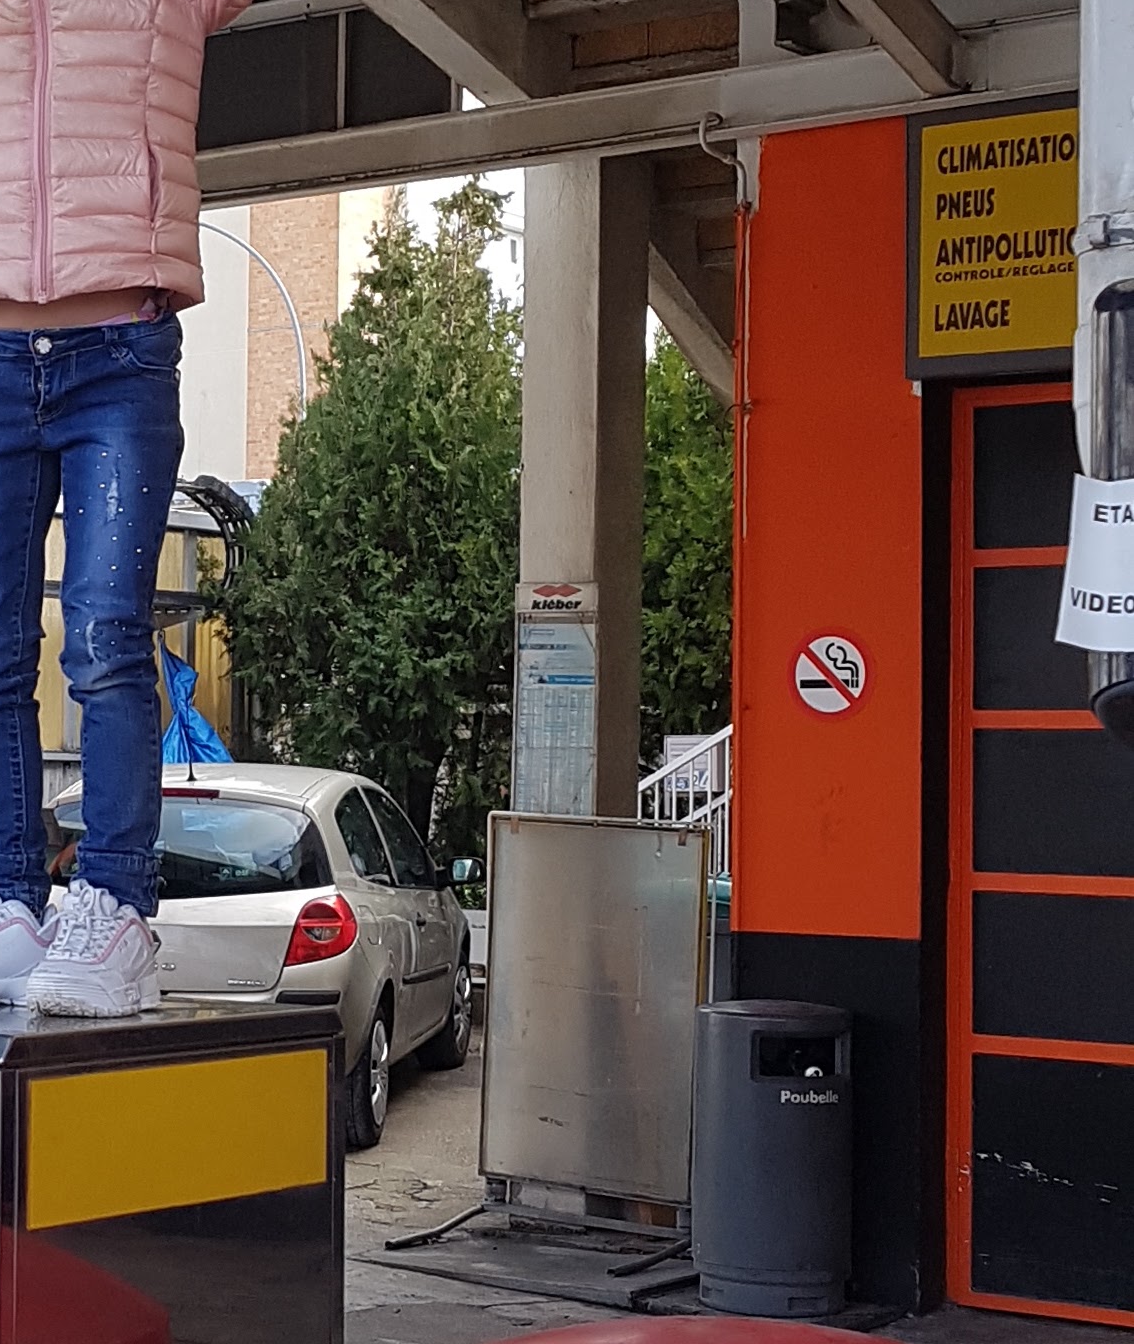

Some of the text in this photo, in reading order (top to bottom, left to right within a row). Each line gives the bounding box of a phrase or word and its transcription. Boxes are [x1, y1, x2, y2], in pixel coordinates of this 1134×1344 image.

[936, 188, 995, 220] PNEUS
[935, 261, 1075, 283] CONTROLE/REGLAGE
[934, 299, 1011, 332] LAVAGE
[780, 1089, 839, 1104] Poubelle
